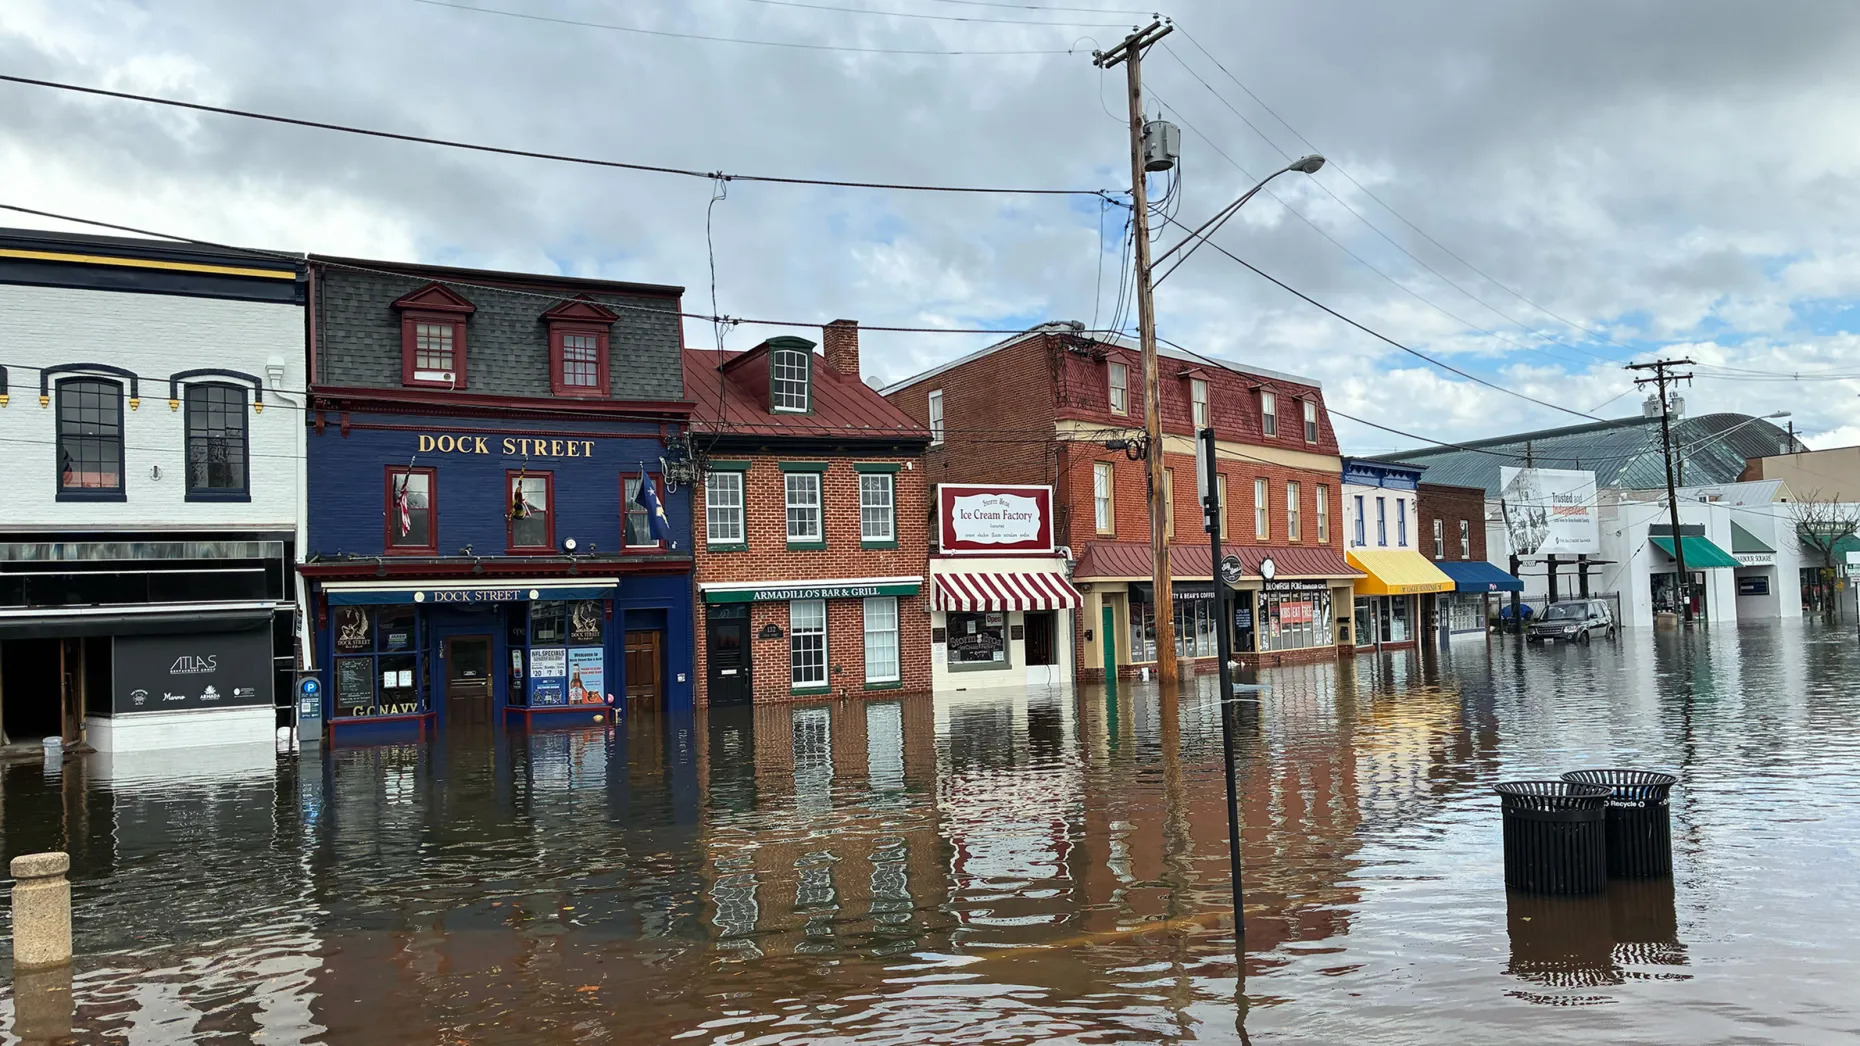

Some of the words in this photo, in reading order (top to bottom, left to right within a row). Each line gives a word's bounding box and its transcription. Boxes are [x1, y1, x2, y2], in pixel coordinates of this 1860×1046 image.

[418, 435, 490, 454] DOCK
[503, 438, 595, 458] STREET
[982, 499, 998, 507] Storm
[1552, 492, 1573, 503] Trusted
[960, 508, 972, 520] Ice
[973, 508, 1001, 520] Cream
[1002, 508, 1033, 523] Factory
[1755, 555, 1772, 563] SQUARE
[434, 591, 470, 602] DOCK
[474, 590, 520, 601] STREET
[753, 590, 820, 601] ARMADILLO'S
[821, 588, 841, 598] BAR
[841, 588, 849, 597] &
[851, 587, 880, 597] GRILL
[987, 615, 1002, 624] Open
[767, 625, 776, 633] 132
[949, 634, 977, 648] Storm
[170, 654, 216, 670] ATLAS
[308, 683, 315, 692] P
[380, 702, 418, 714] NAVY
[1610, 800, 1637, 808] Recycle
